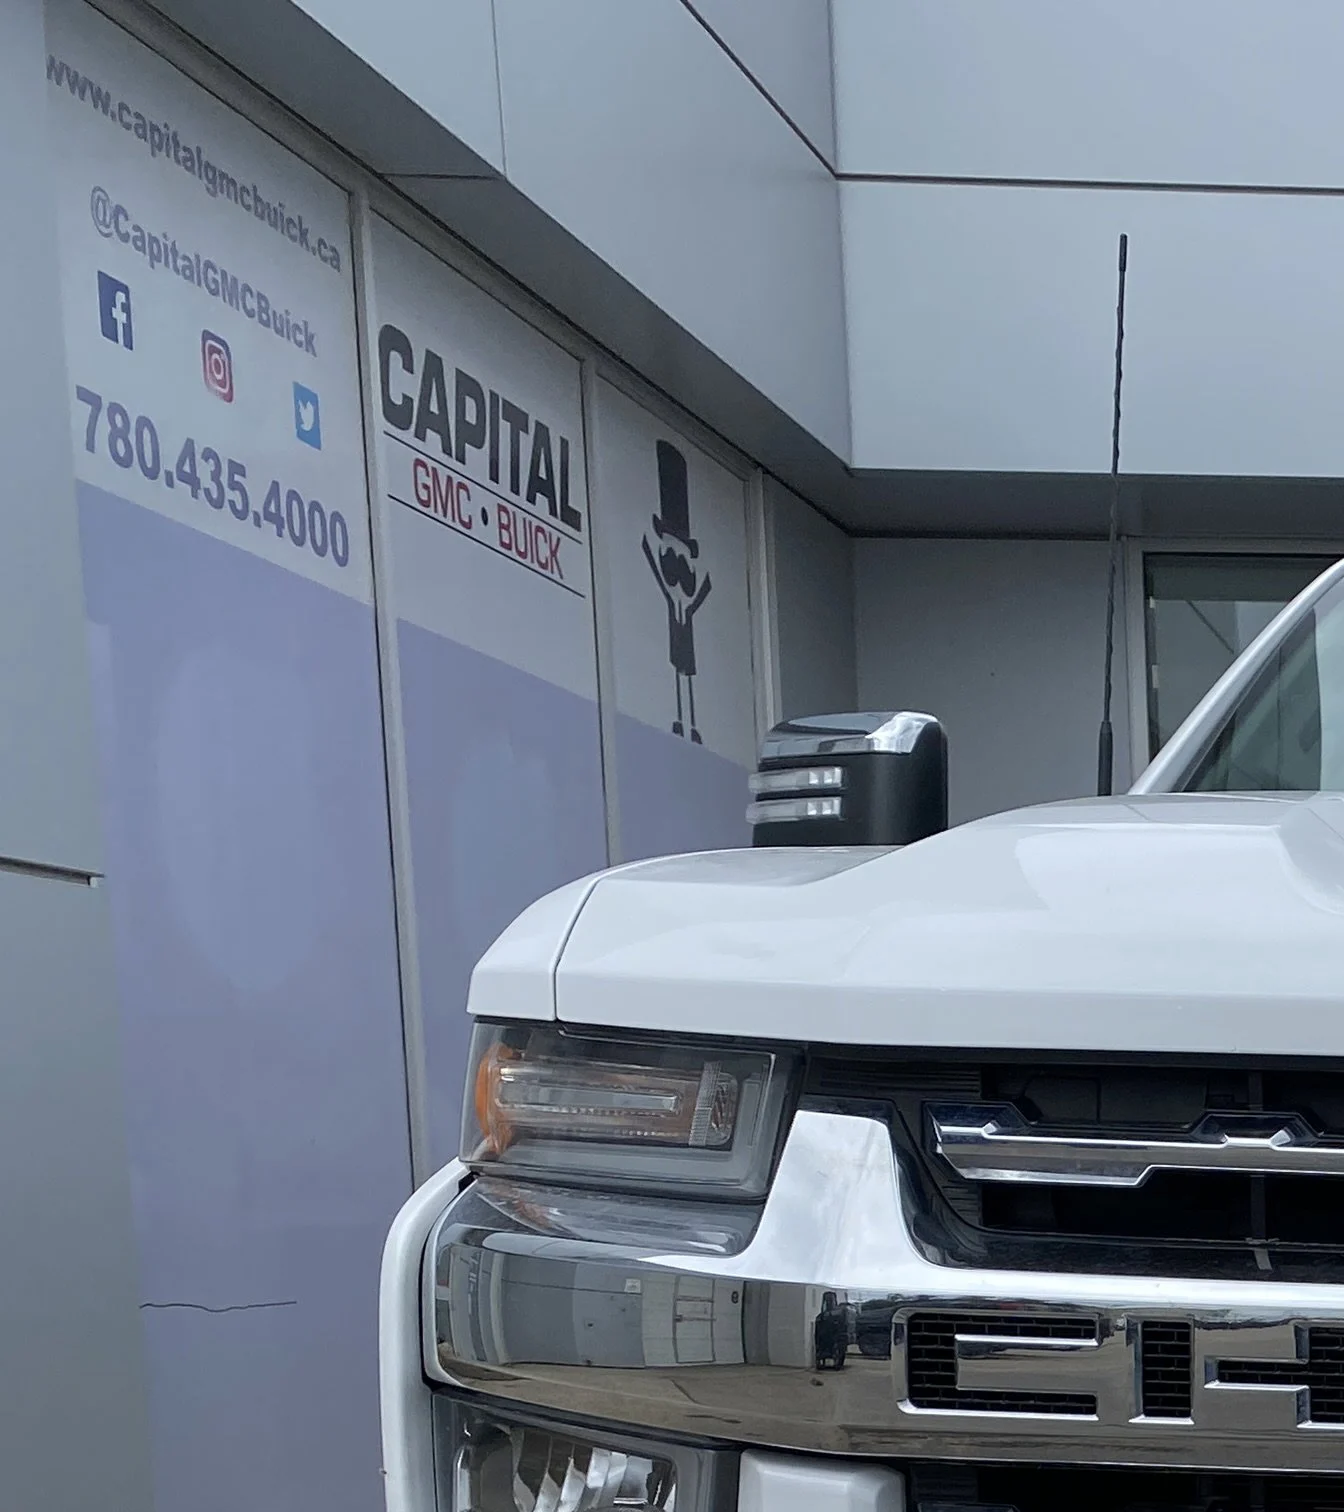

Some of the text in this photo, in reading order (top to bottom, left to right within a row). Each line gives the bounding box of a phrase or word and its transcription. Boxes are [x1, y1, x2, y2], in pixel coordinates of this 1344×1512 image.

[91, 186, 317, 357] @CapitalGMCBuick
[76, 384, 349, 567] 780.435.4000
[378, 324, 582, 532] CAPITAL
[413, 458, 563, 579] GMC BUICK
